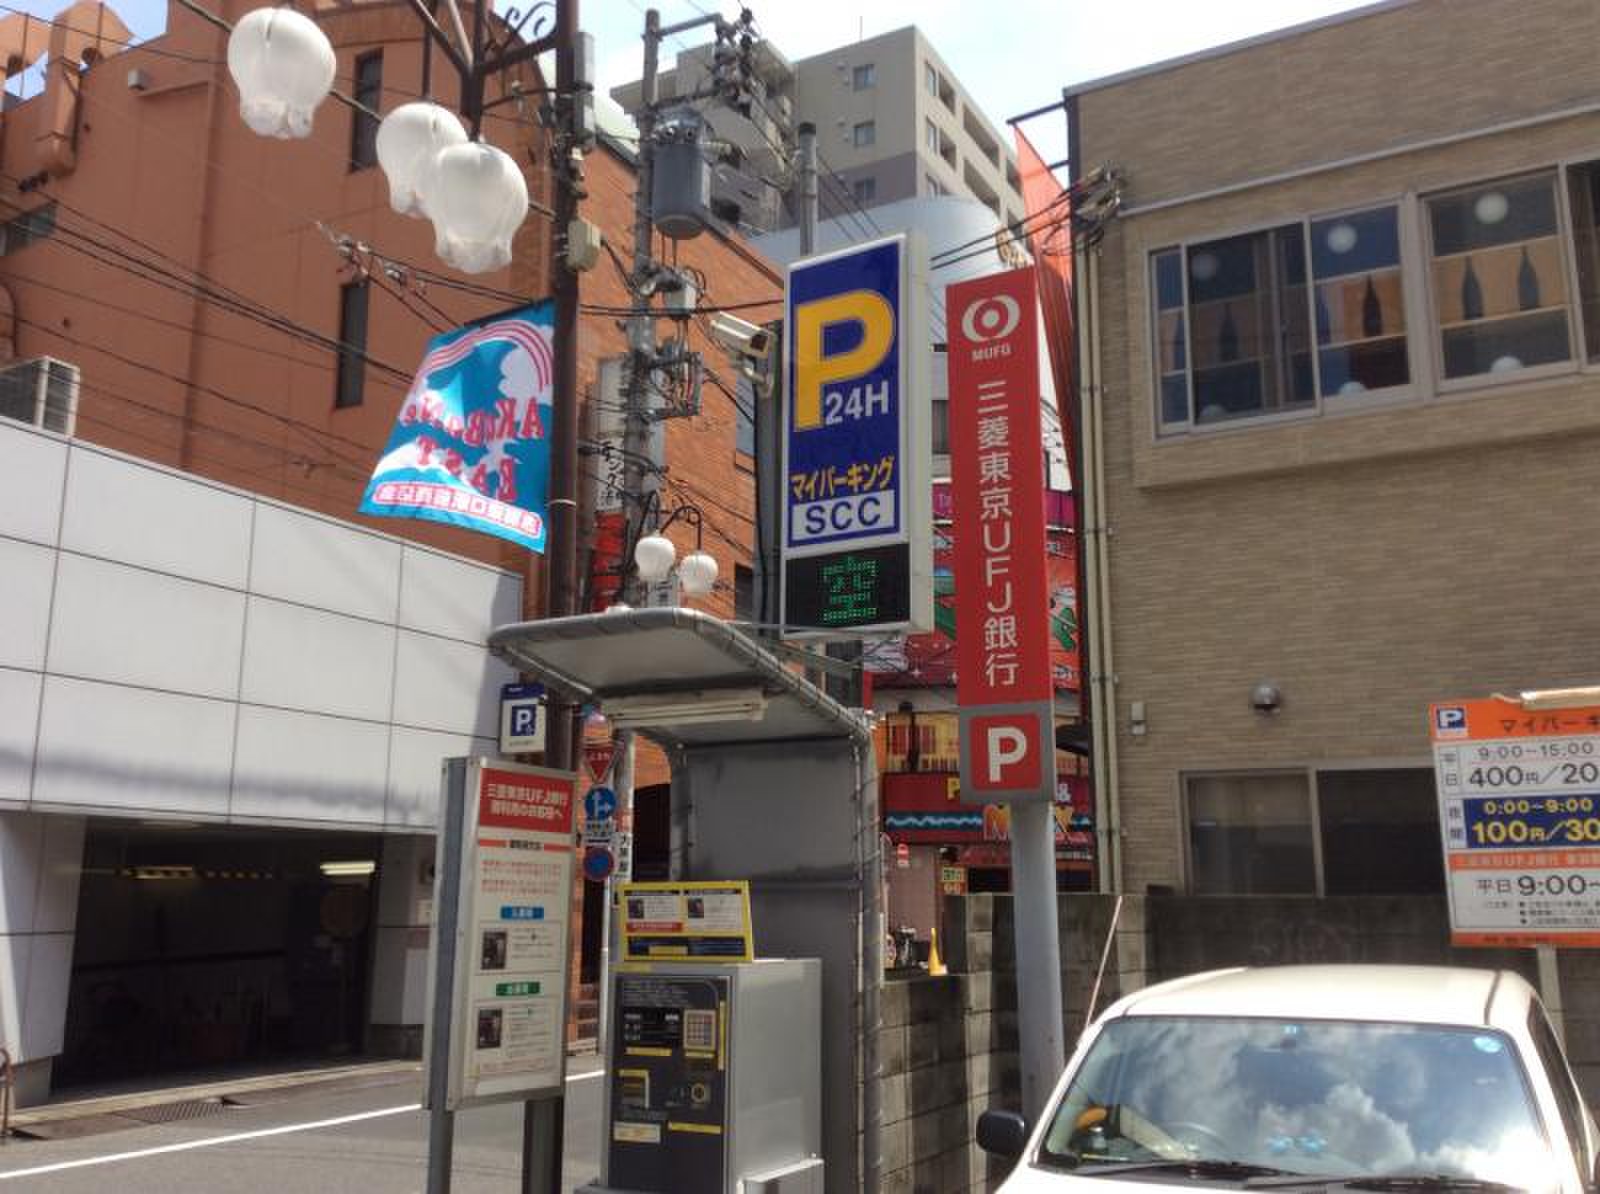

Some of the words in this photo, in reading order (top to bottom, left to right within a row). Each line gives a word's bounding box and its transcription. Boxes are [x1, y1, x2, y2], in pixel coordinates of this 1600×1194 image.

[794, 289, 896, 432] P
[824, 380, 889, 426] 24H
[790, 455, 895, 500] マイパーキング
[804, 497, 880, 536] SCC
[977, 379, 1019, 687] 三菱東京UFJ銀行
[516, 709, 532, 733] P
[1439, 709, 1464, 729] P
[987, 727, 1027, 782] P
